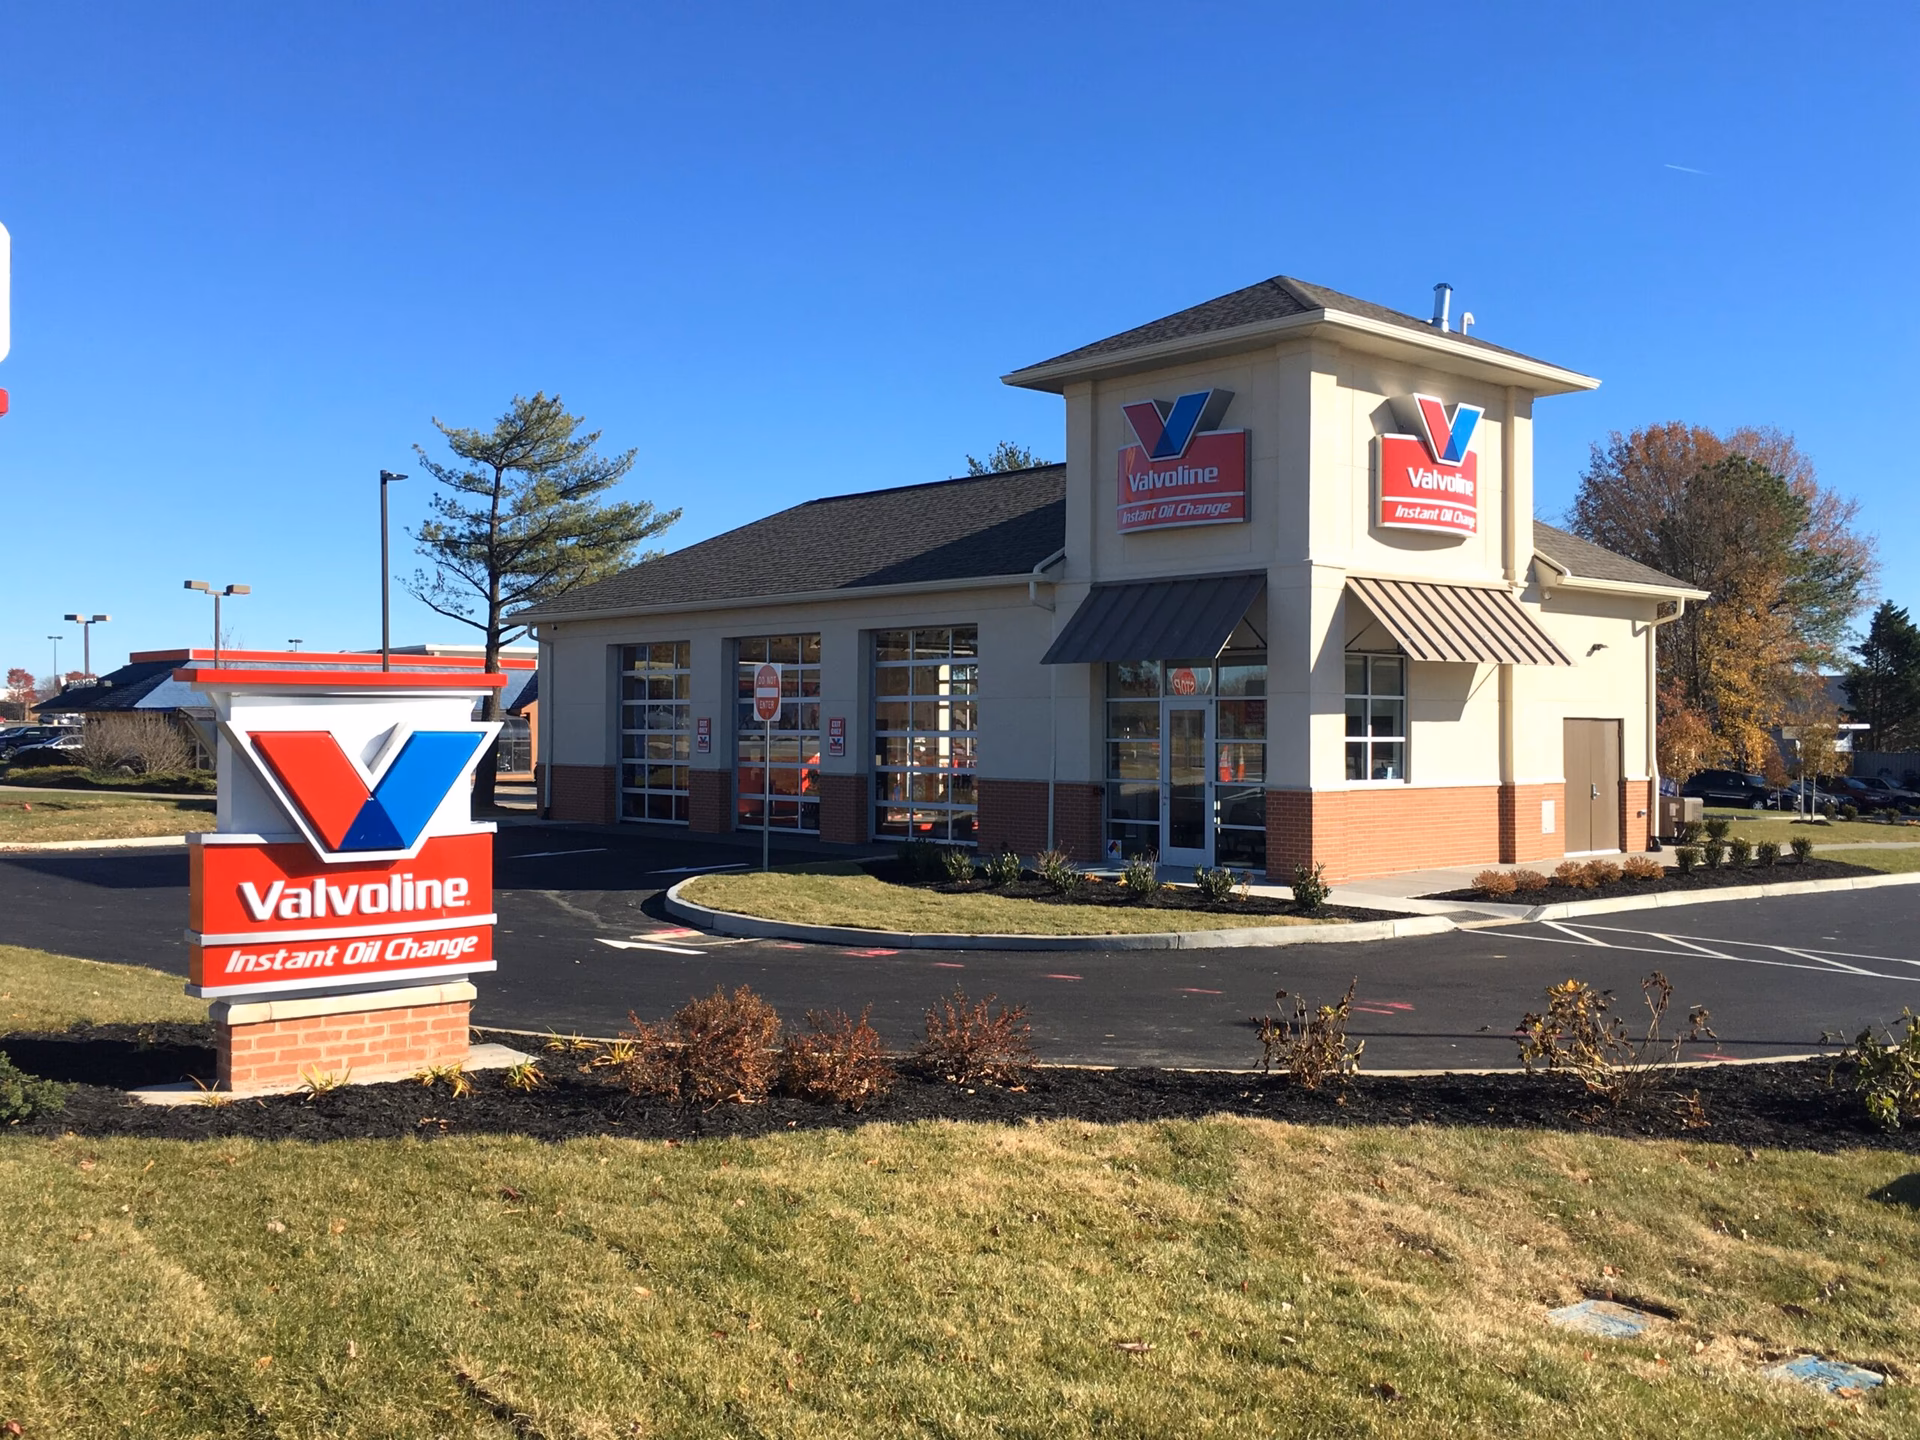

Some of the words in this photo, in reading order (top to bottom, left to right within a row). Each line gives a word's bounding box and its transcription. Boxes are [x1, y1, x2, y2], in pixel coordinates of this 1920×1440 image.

[1128, 465, 1218, 492] Valvoline
[1407, 467, 1474, 496] Valvoline
[1122, 507, 1157, 524] Instant
[1158, 504, 1177, 519] Oil
[1176, 502, 1231, 516] Change
[1395, 504, 1439, 520] Instant
[758, 675, 765, 685] DO
[766, 675, 777, 685] NOT
[759, 700, 775, 709] ENTER
[239, 873, 469, 921] Valvoline
[224, 945, 340, 974] Instant
[342, 943, 380, 964] Oil
[384, 935, 479, 962] Change
